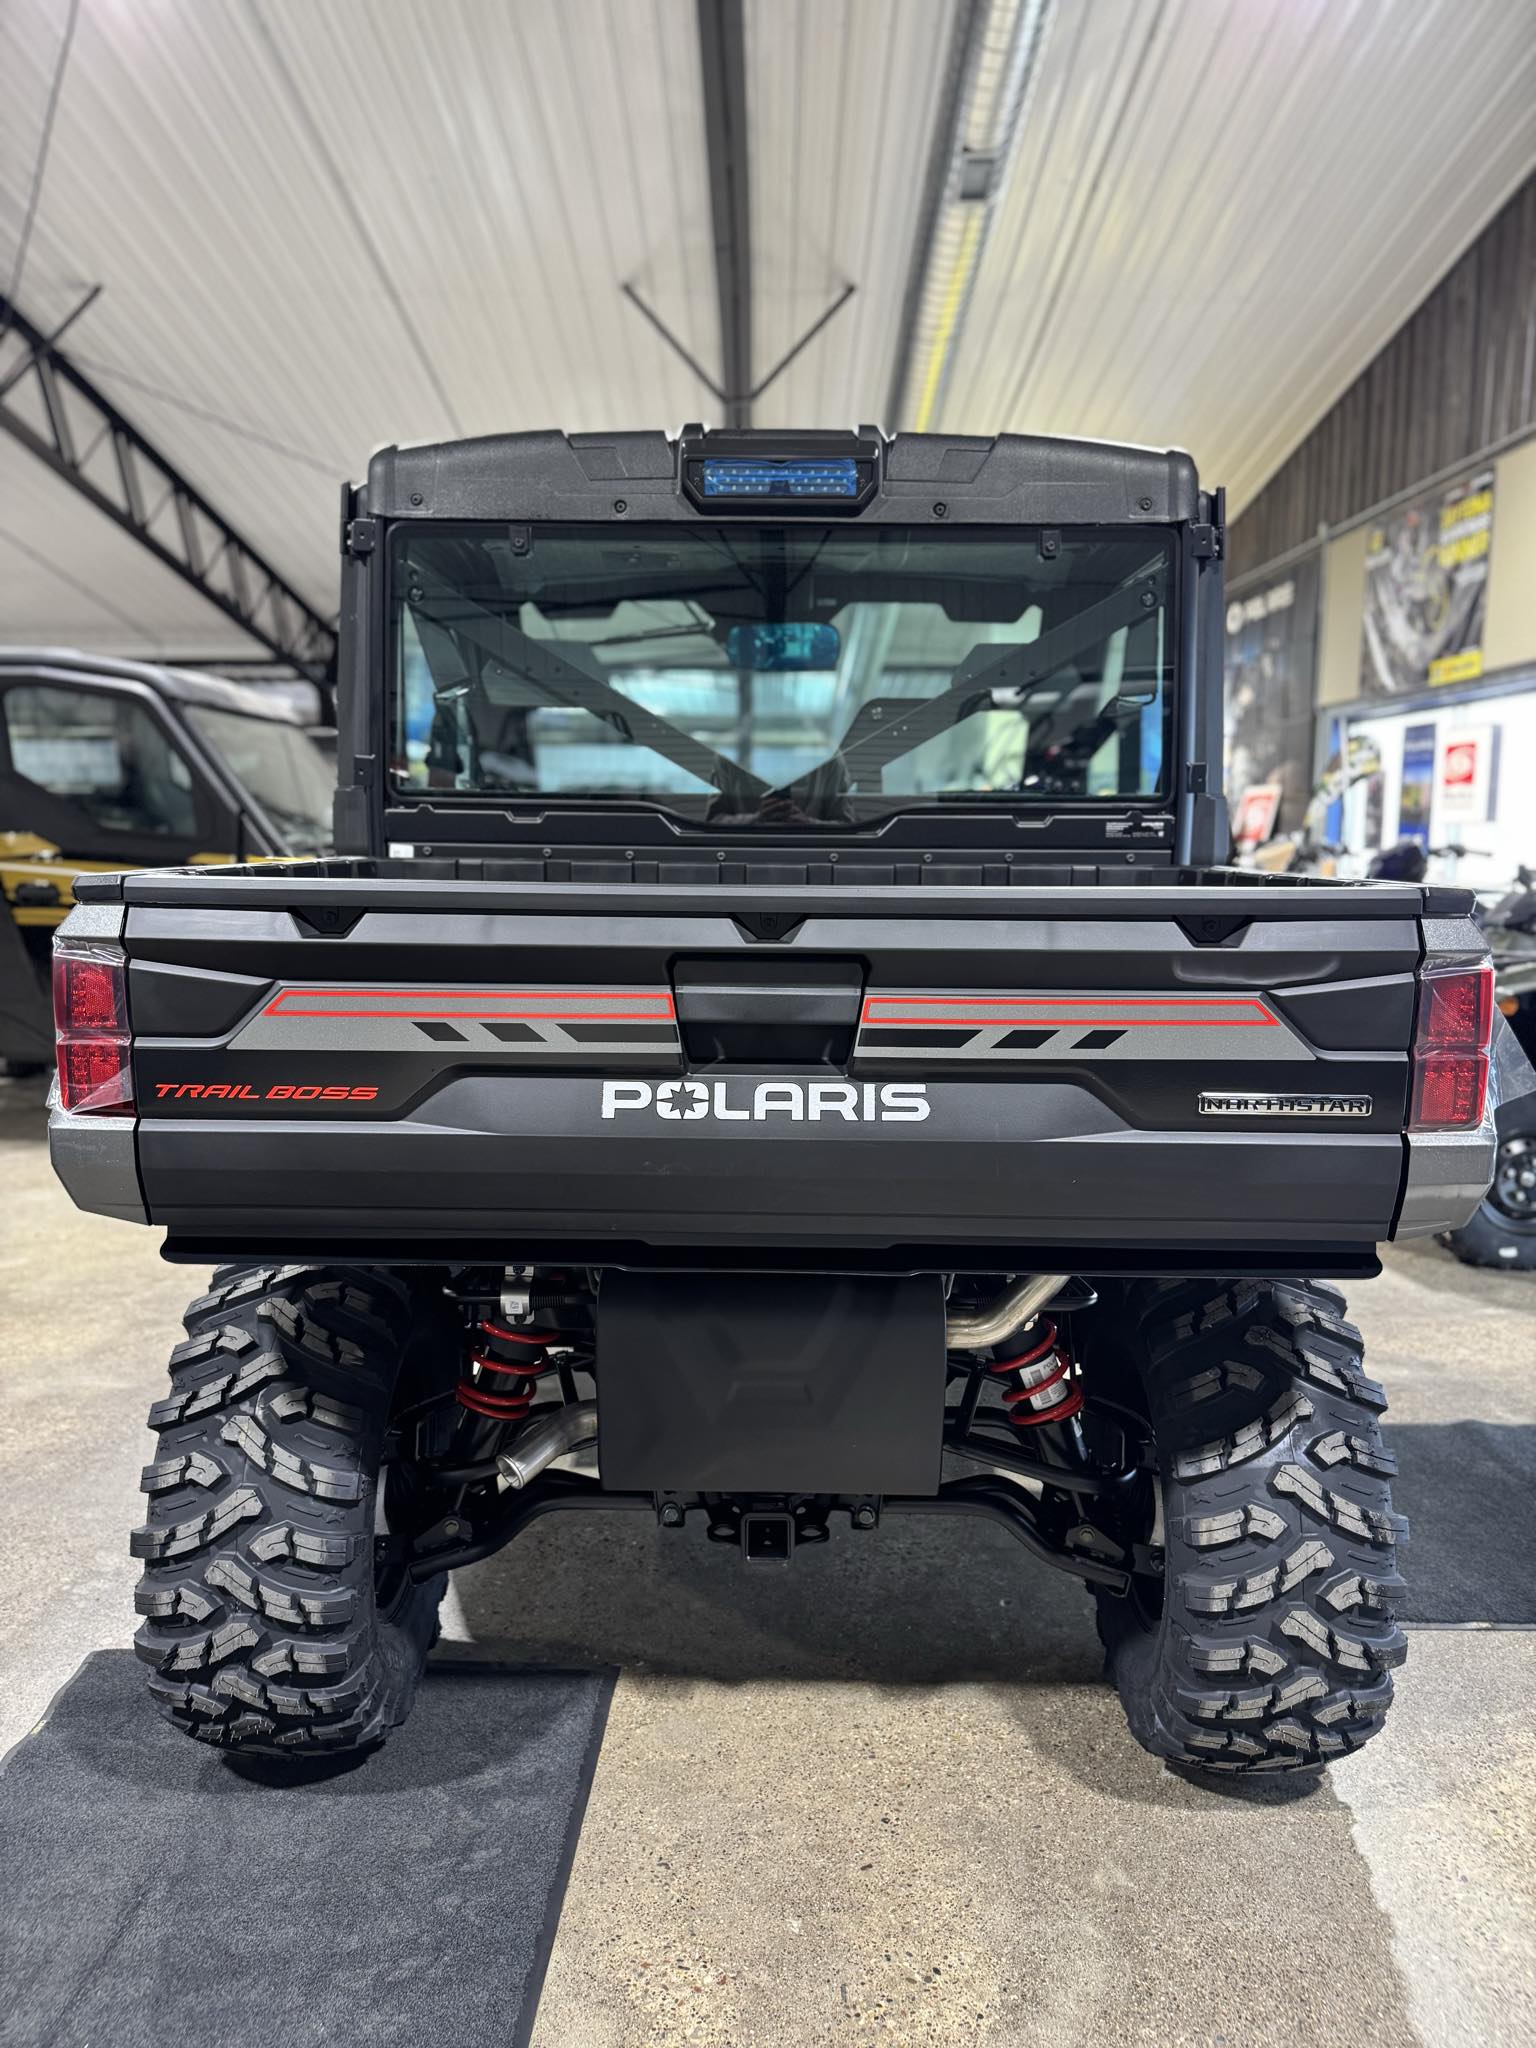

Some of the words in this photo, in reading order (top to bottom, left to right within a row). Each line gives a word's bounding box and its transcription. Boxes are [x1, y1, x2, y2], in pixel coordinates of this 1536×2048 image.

[155, 1084, 260, 1099] TRAIL
[265, 1085, 379, 1100] BOSS
[601, 1081, 931, 1122] POLARIS
[1206, 1098, 1365, 1113] NORTHSTAR
